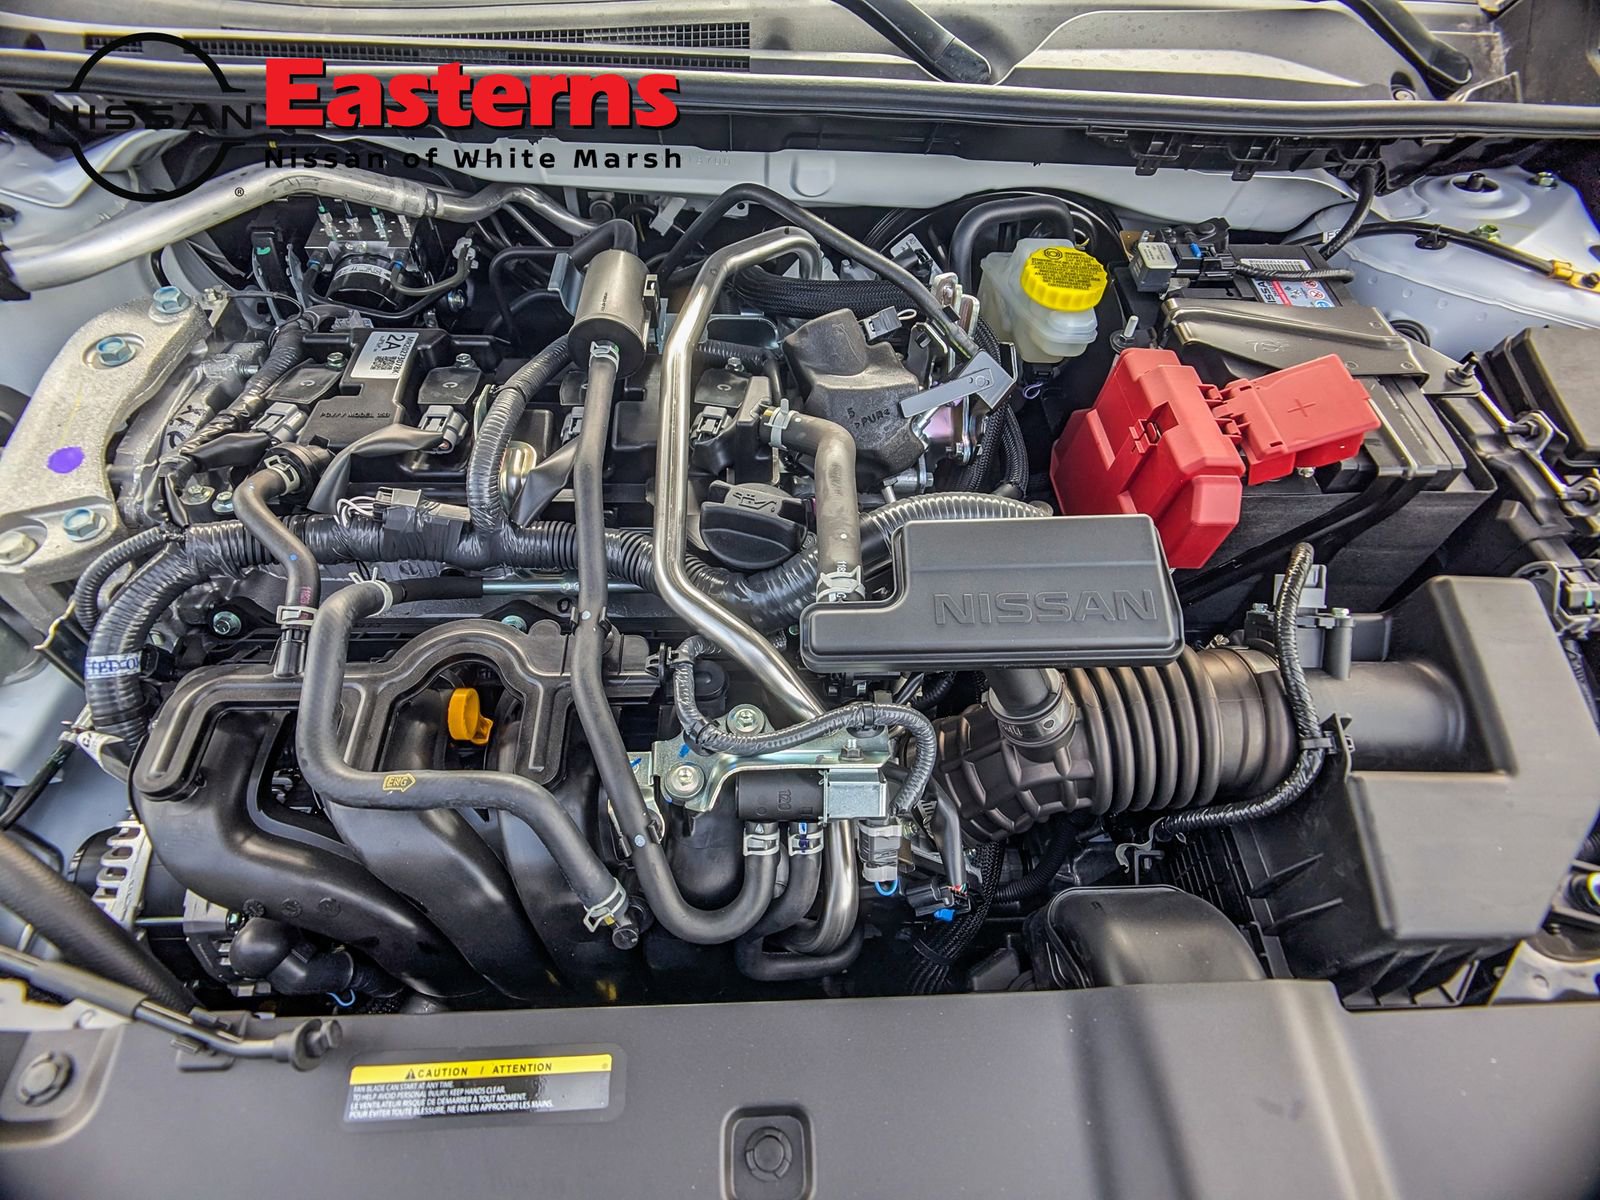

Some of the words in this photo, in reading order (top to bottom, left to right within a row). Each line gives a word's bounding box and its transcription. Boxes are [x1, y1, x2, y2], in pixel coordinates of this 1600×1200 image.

[934, 589, 1158, 625] NISSAN
[386, 776, 408, 787] ENG
[418, 1067, 469, 1079] CAUTION
[492, 1062, 553, 1074] ATTENTION
